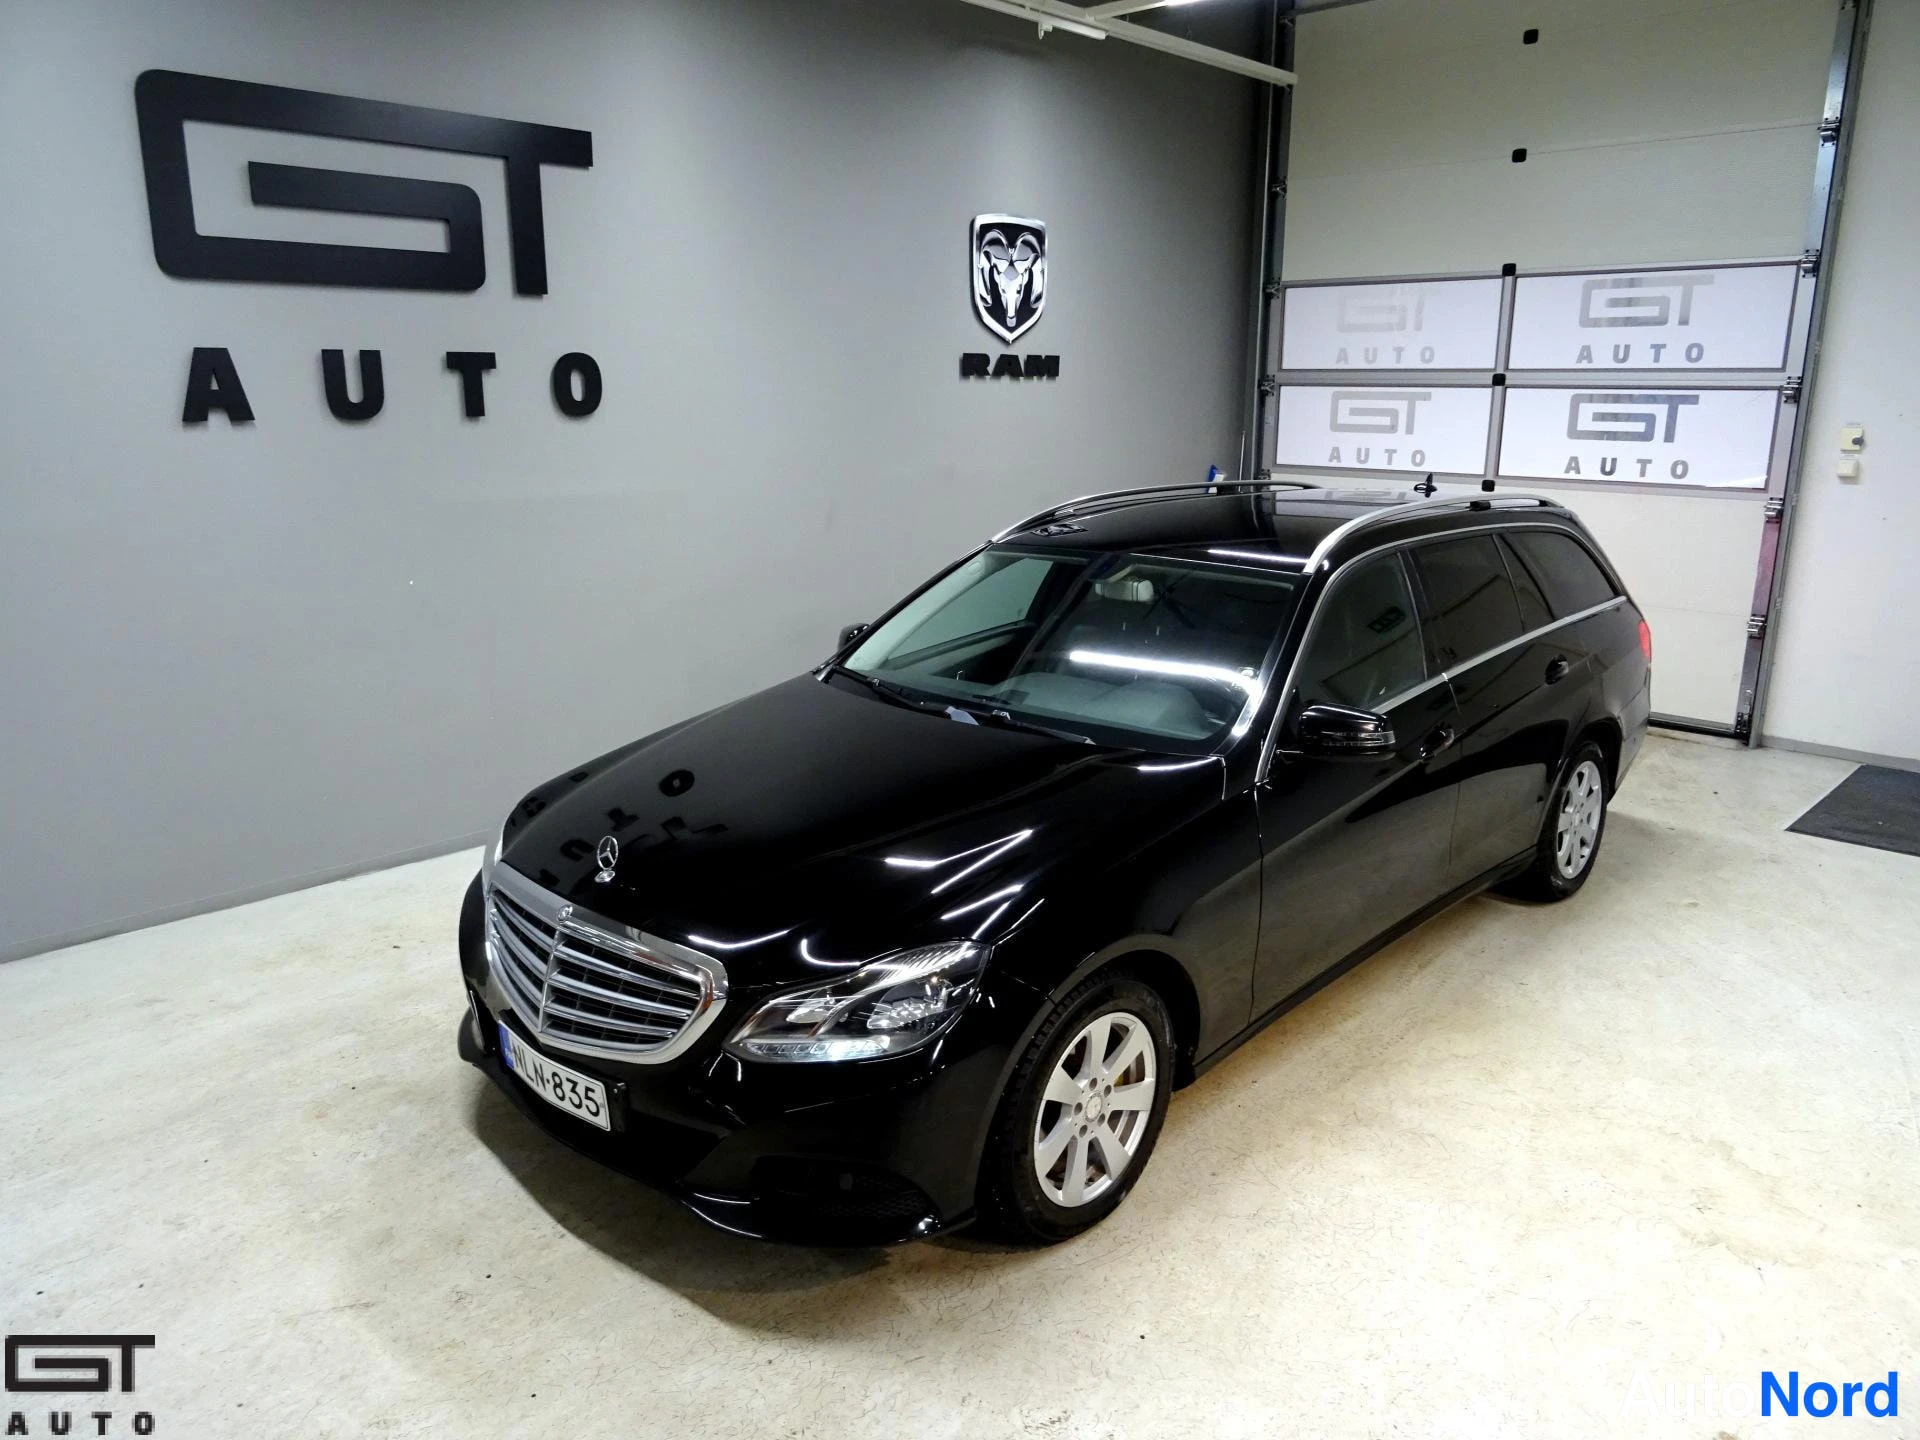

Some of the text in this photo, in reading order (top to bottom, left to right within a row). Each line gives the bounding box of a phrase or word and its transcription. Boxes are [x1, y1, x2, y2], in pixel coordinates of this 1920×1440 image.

[135, 69, 593, 296] GT
[1579, 274, 1715, 328] GT
[961, 352, 1060, 380] RAM
[1336, 346, 1435, 364] AUTO
[1576, 343, 1704, 364] AUTO
[182, 346, 602, 423] AUTO
[1330, 391, 1431, 435] GT
[1567, 393, 1699, 443] GT
[1328, 446, 1426, 467] AUTO
[1564, 456, 1689, 480] AUTO
[512, 1040, 600, 1117] NLN-835
